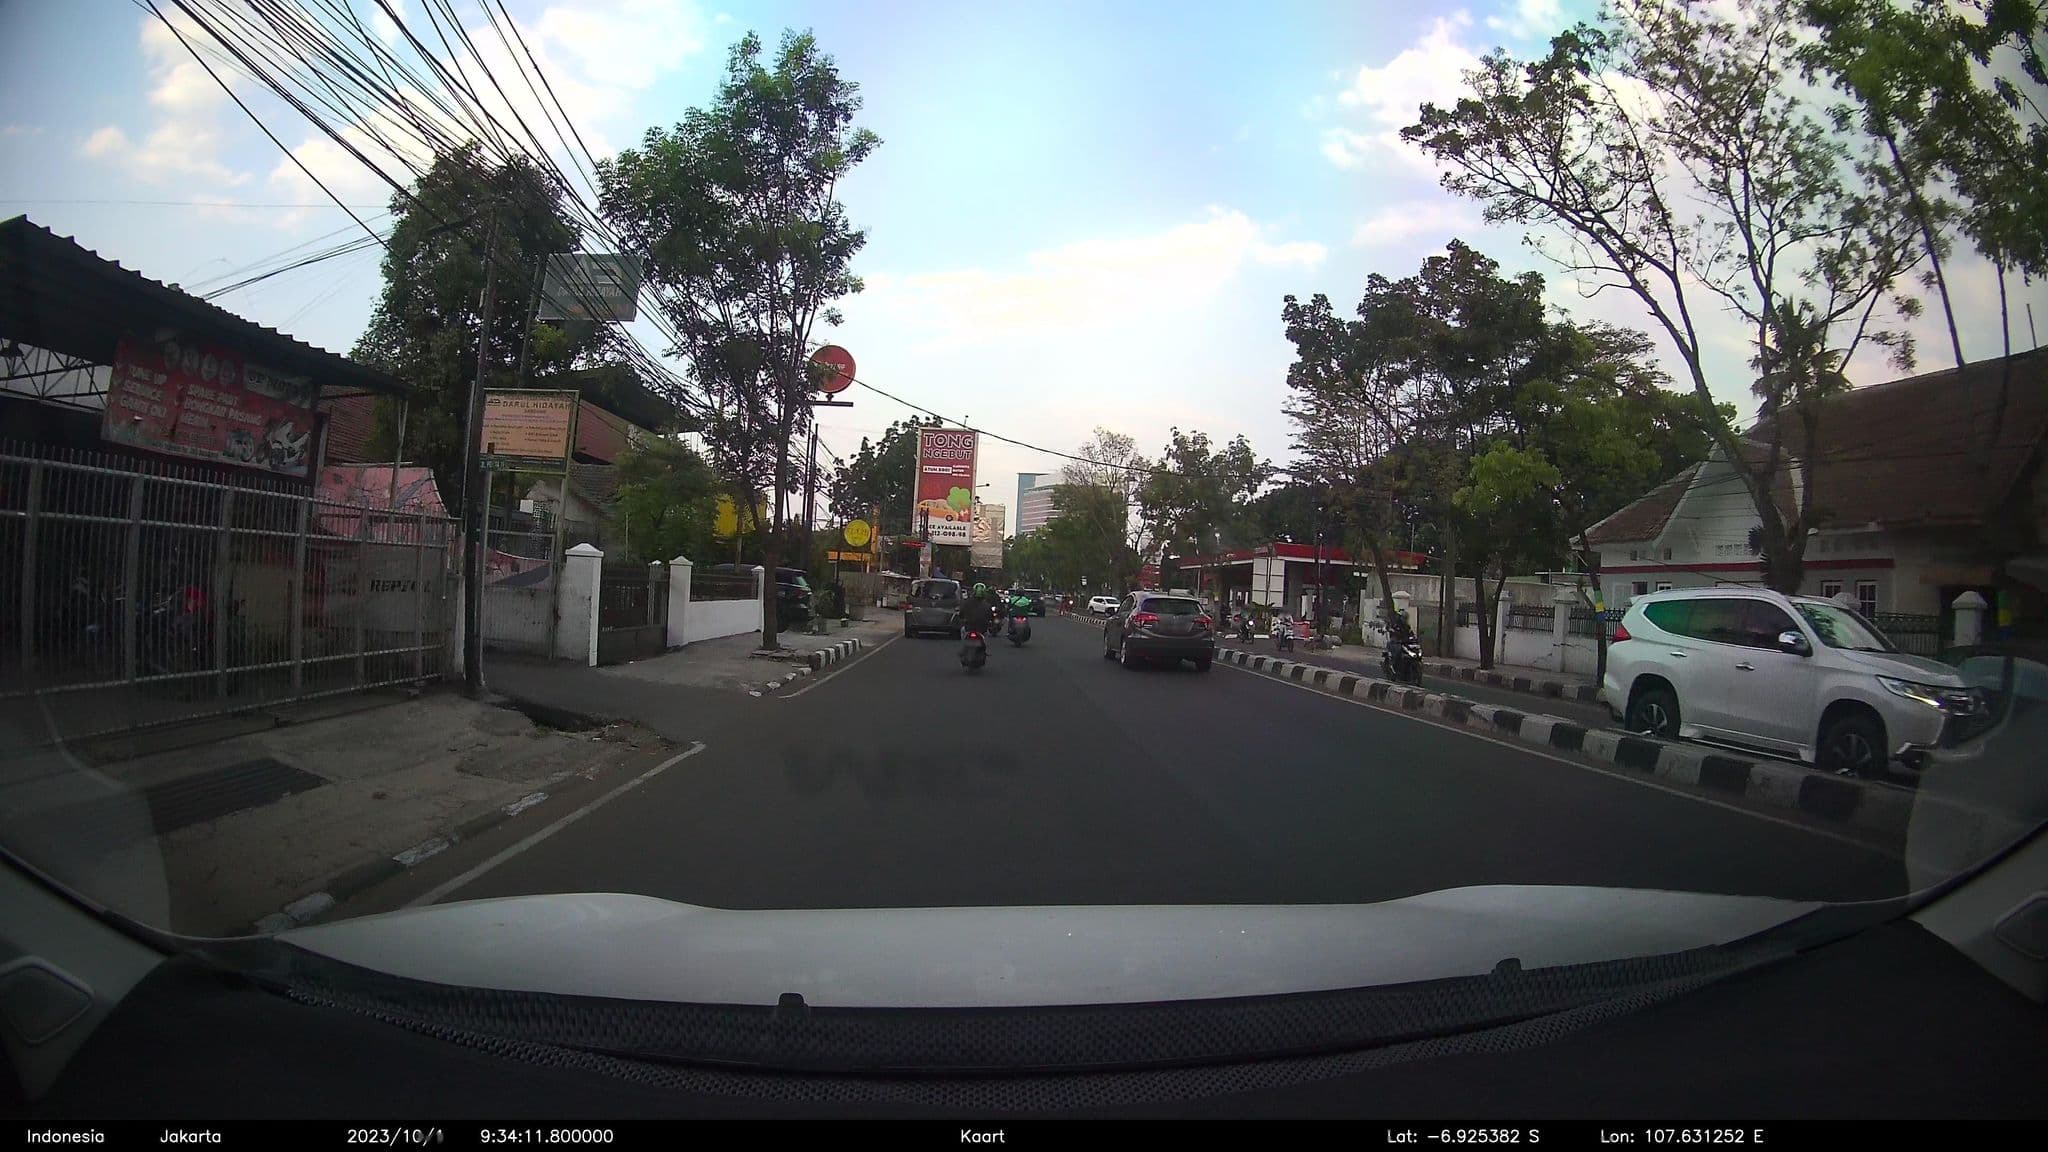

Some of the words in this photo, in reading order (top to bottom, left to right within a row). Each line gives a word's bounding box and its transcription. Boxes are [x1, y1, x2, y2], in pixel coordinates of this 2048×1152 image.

[502, 400, 530, 409] DARUL
[923, 433, 974, 449] TONG
[923, 448, 973, 460] NGEBUT
